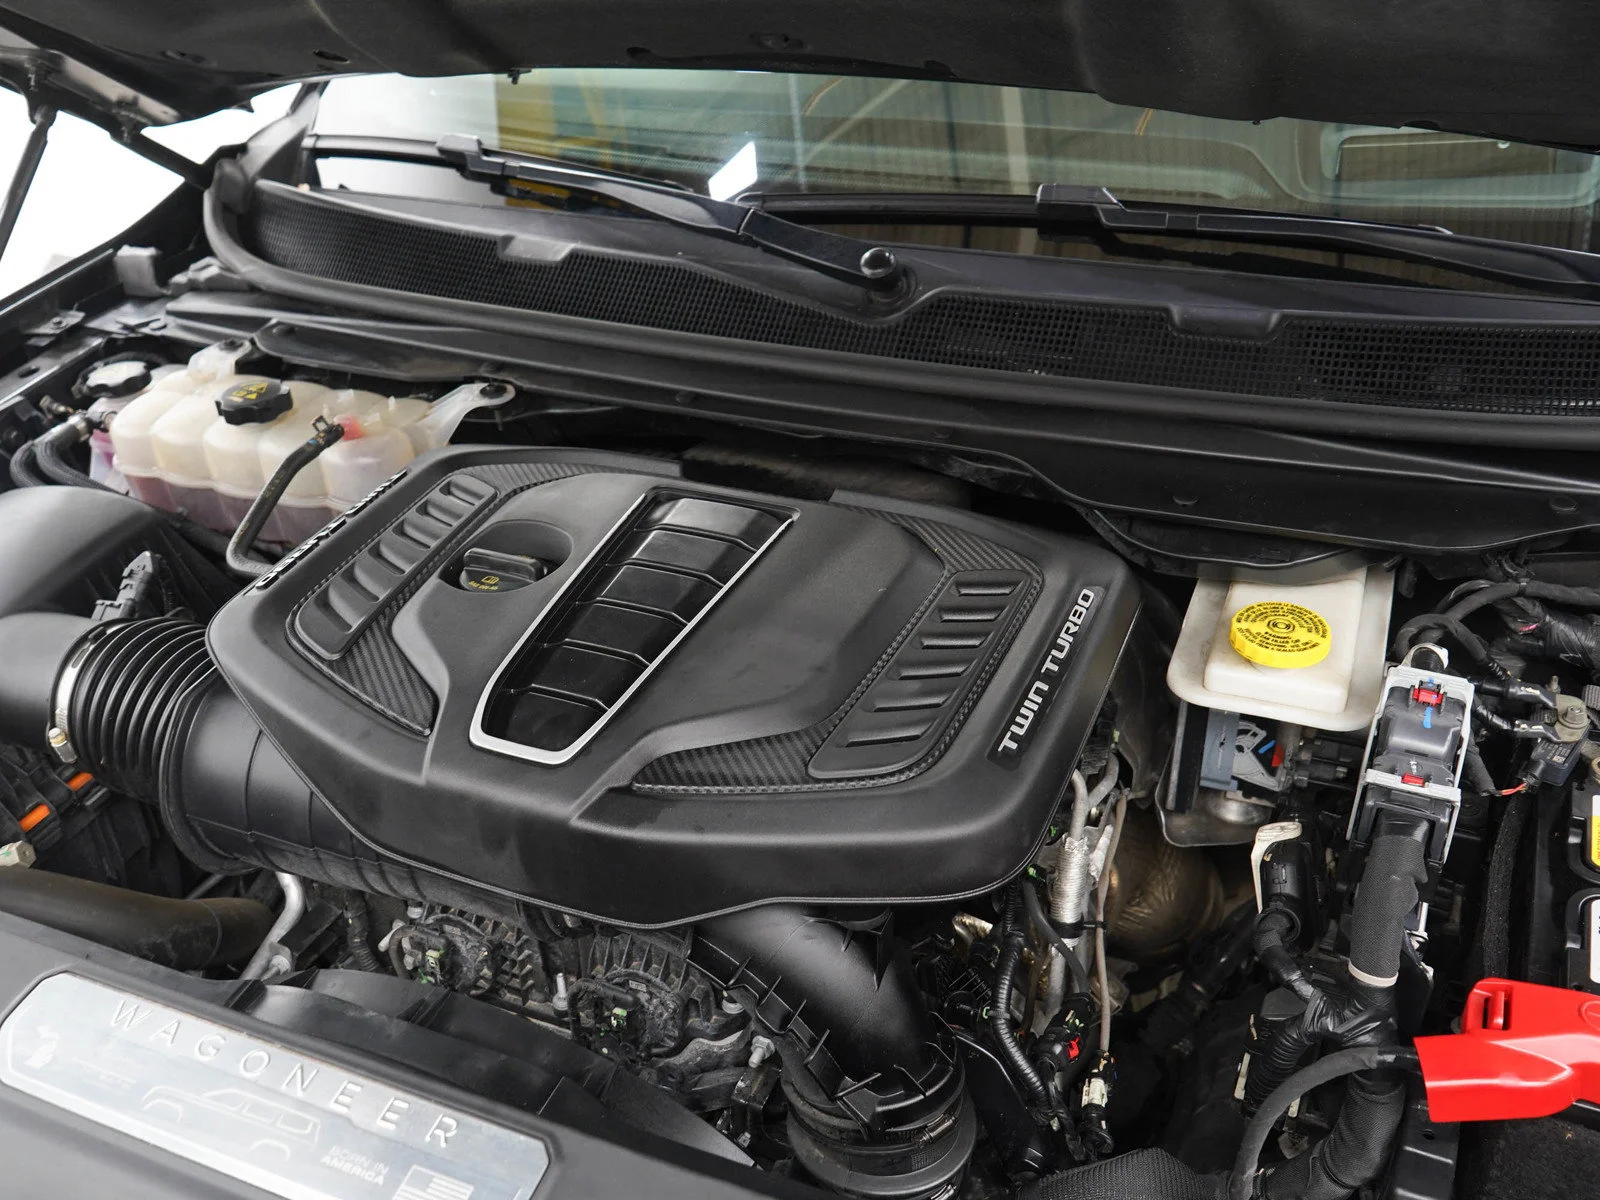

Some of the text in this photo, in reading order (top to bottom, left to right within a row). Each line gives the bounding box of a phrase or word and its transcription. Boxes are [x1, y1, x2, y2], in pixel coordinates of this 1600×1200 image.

[998, 588, 1095, 752] TWIN TURBO
[112, 999, 458, 1148] WAGONEER
[320, 1155, 385, 1187] AMERICA
